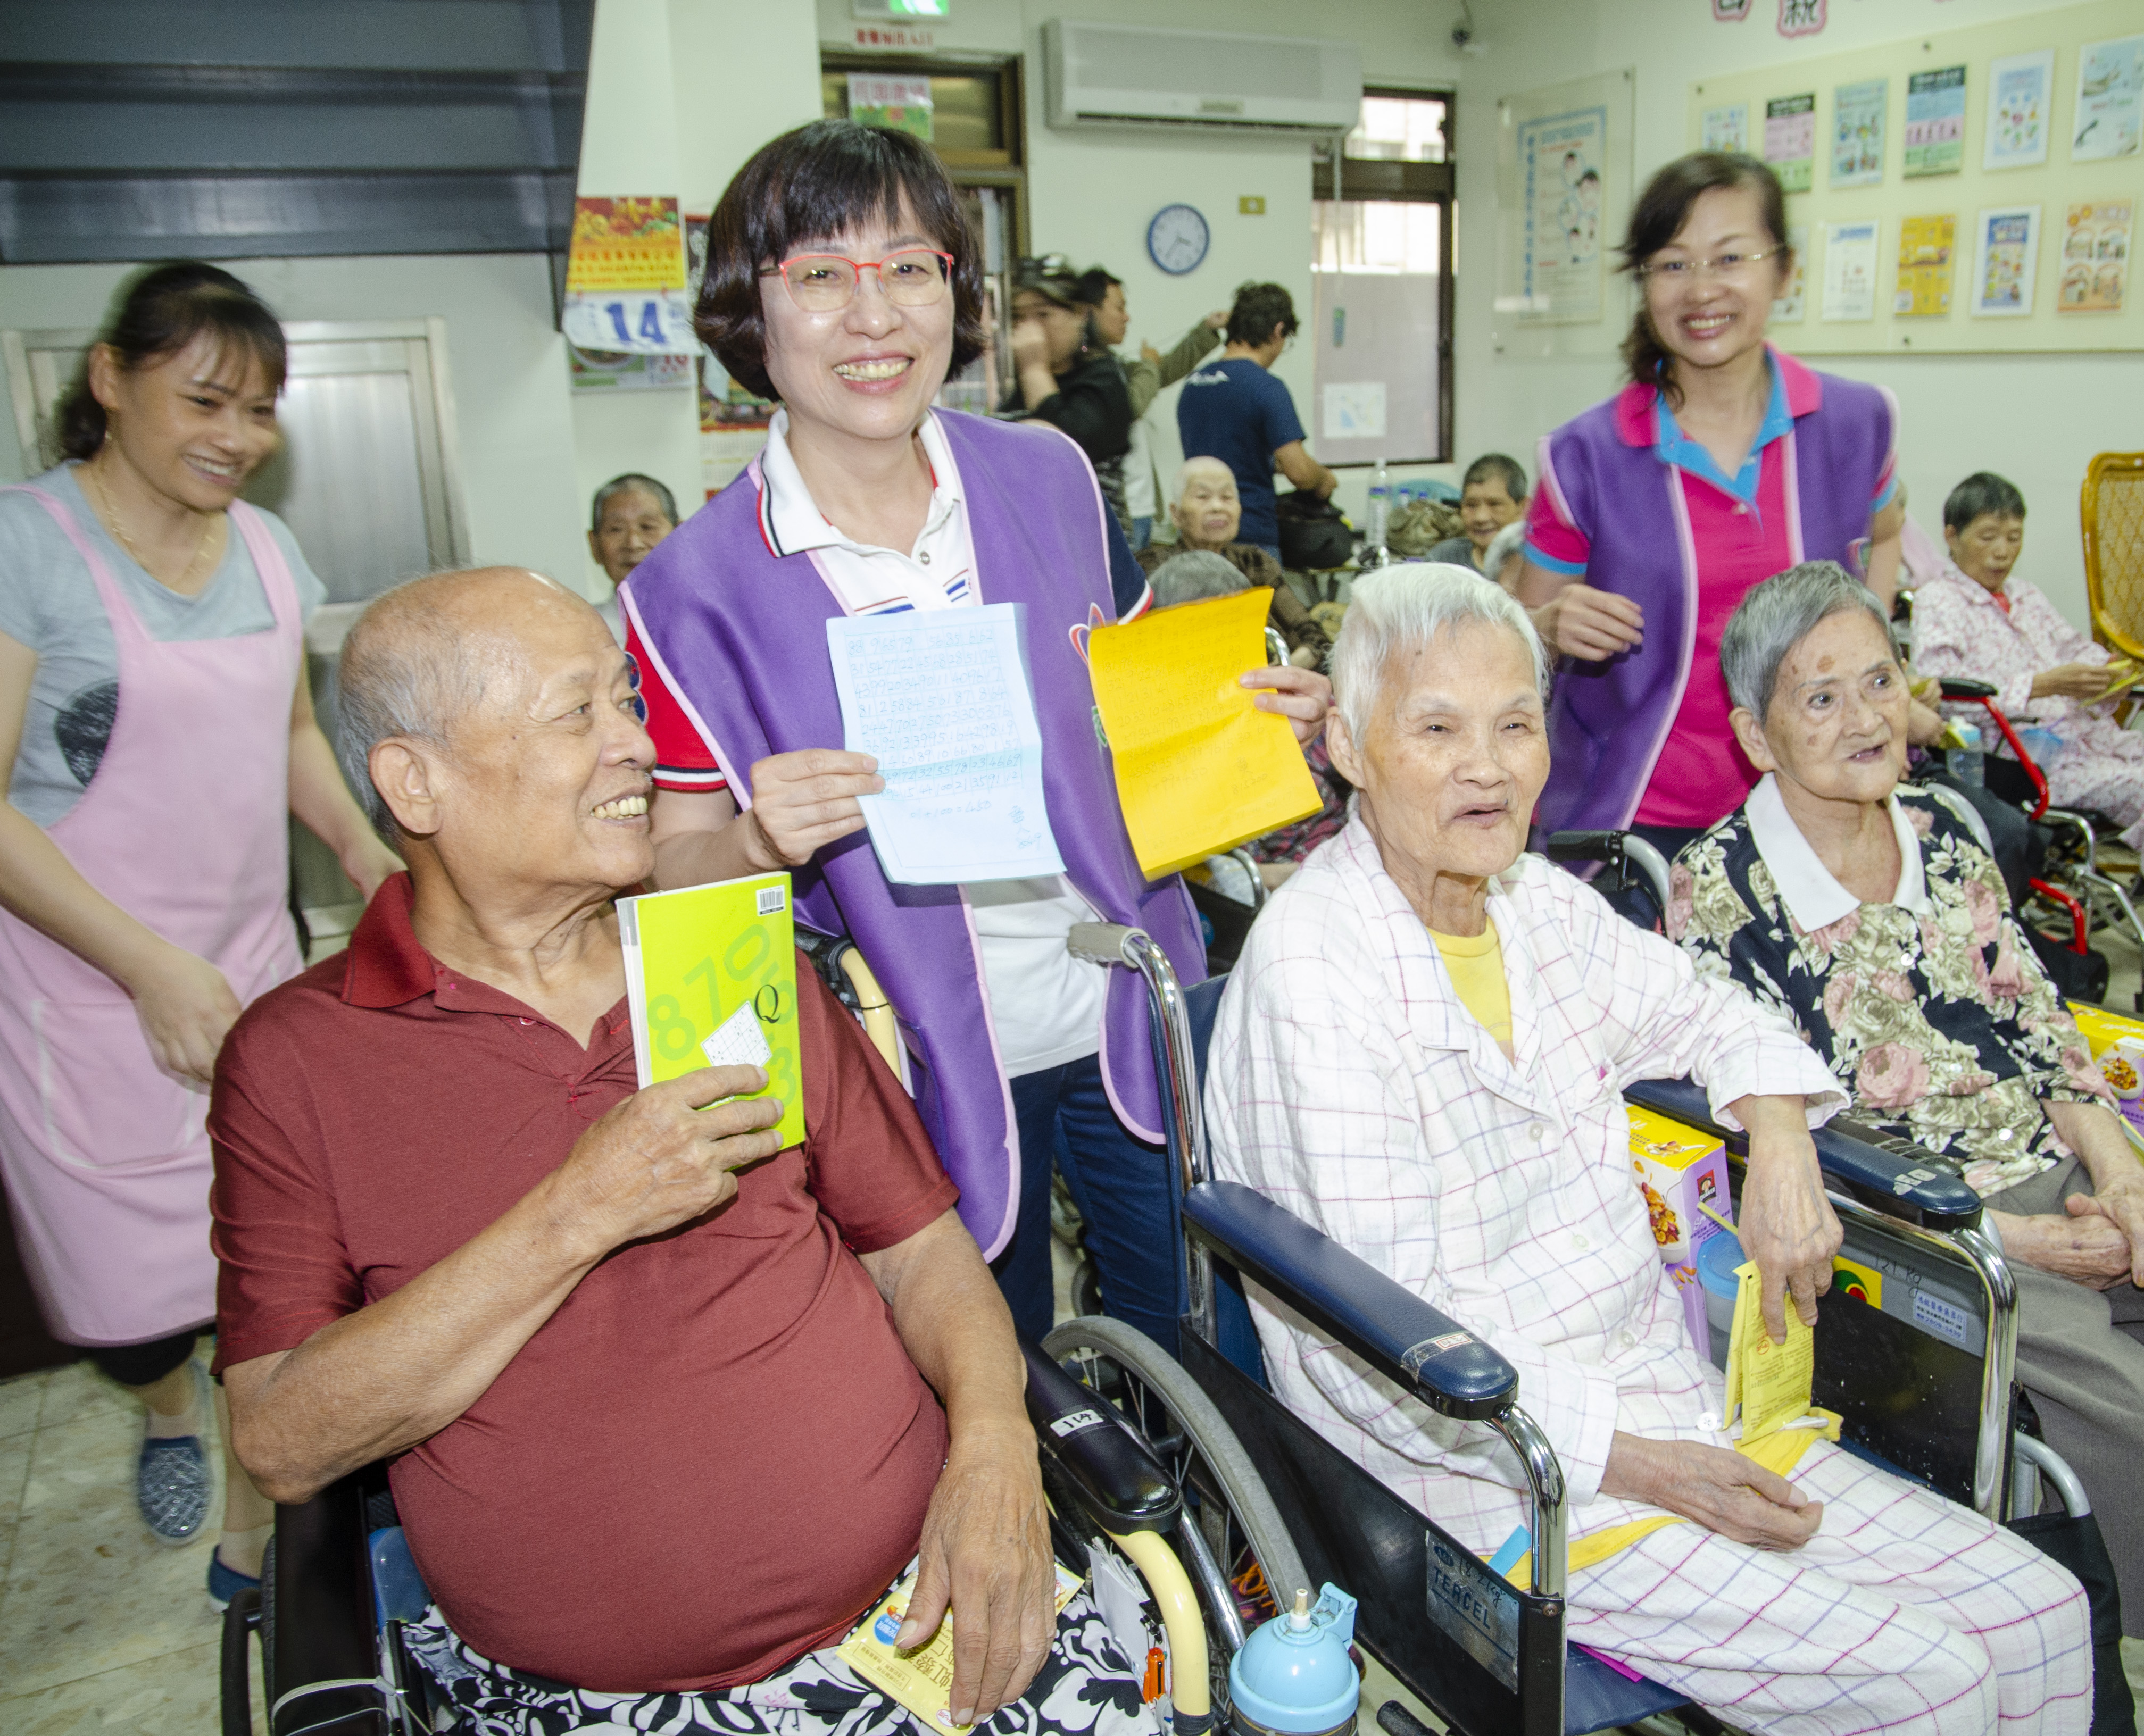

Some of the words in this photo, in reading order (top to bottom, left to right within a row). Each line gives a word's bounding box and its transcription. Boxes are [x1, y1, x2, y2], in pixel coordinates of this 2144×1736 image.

[606, 300, 668, 345] 14
[901, 770, 916, 781] 72
[918, 767, 932, 779] 32
[935, 765, 952, 776] 55
[954, 762, 968, 775] 78
[972, 757, 986, 769] 23
[988, 755, 1004, 767] 46
[1006, 753, 1021, 766] 69
[1434, 1566, 1491, 1630] TERCEL
